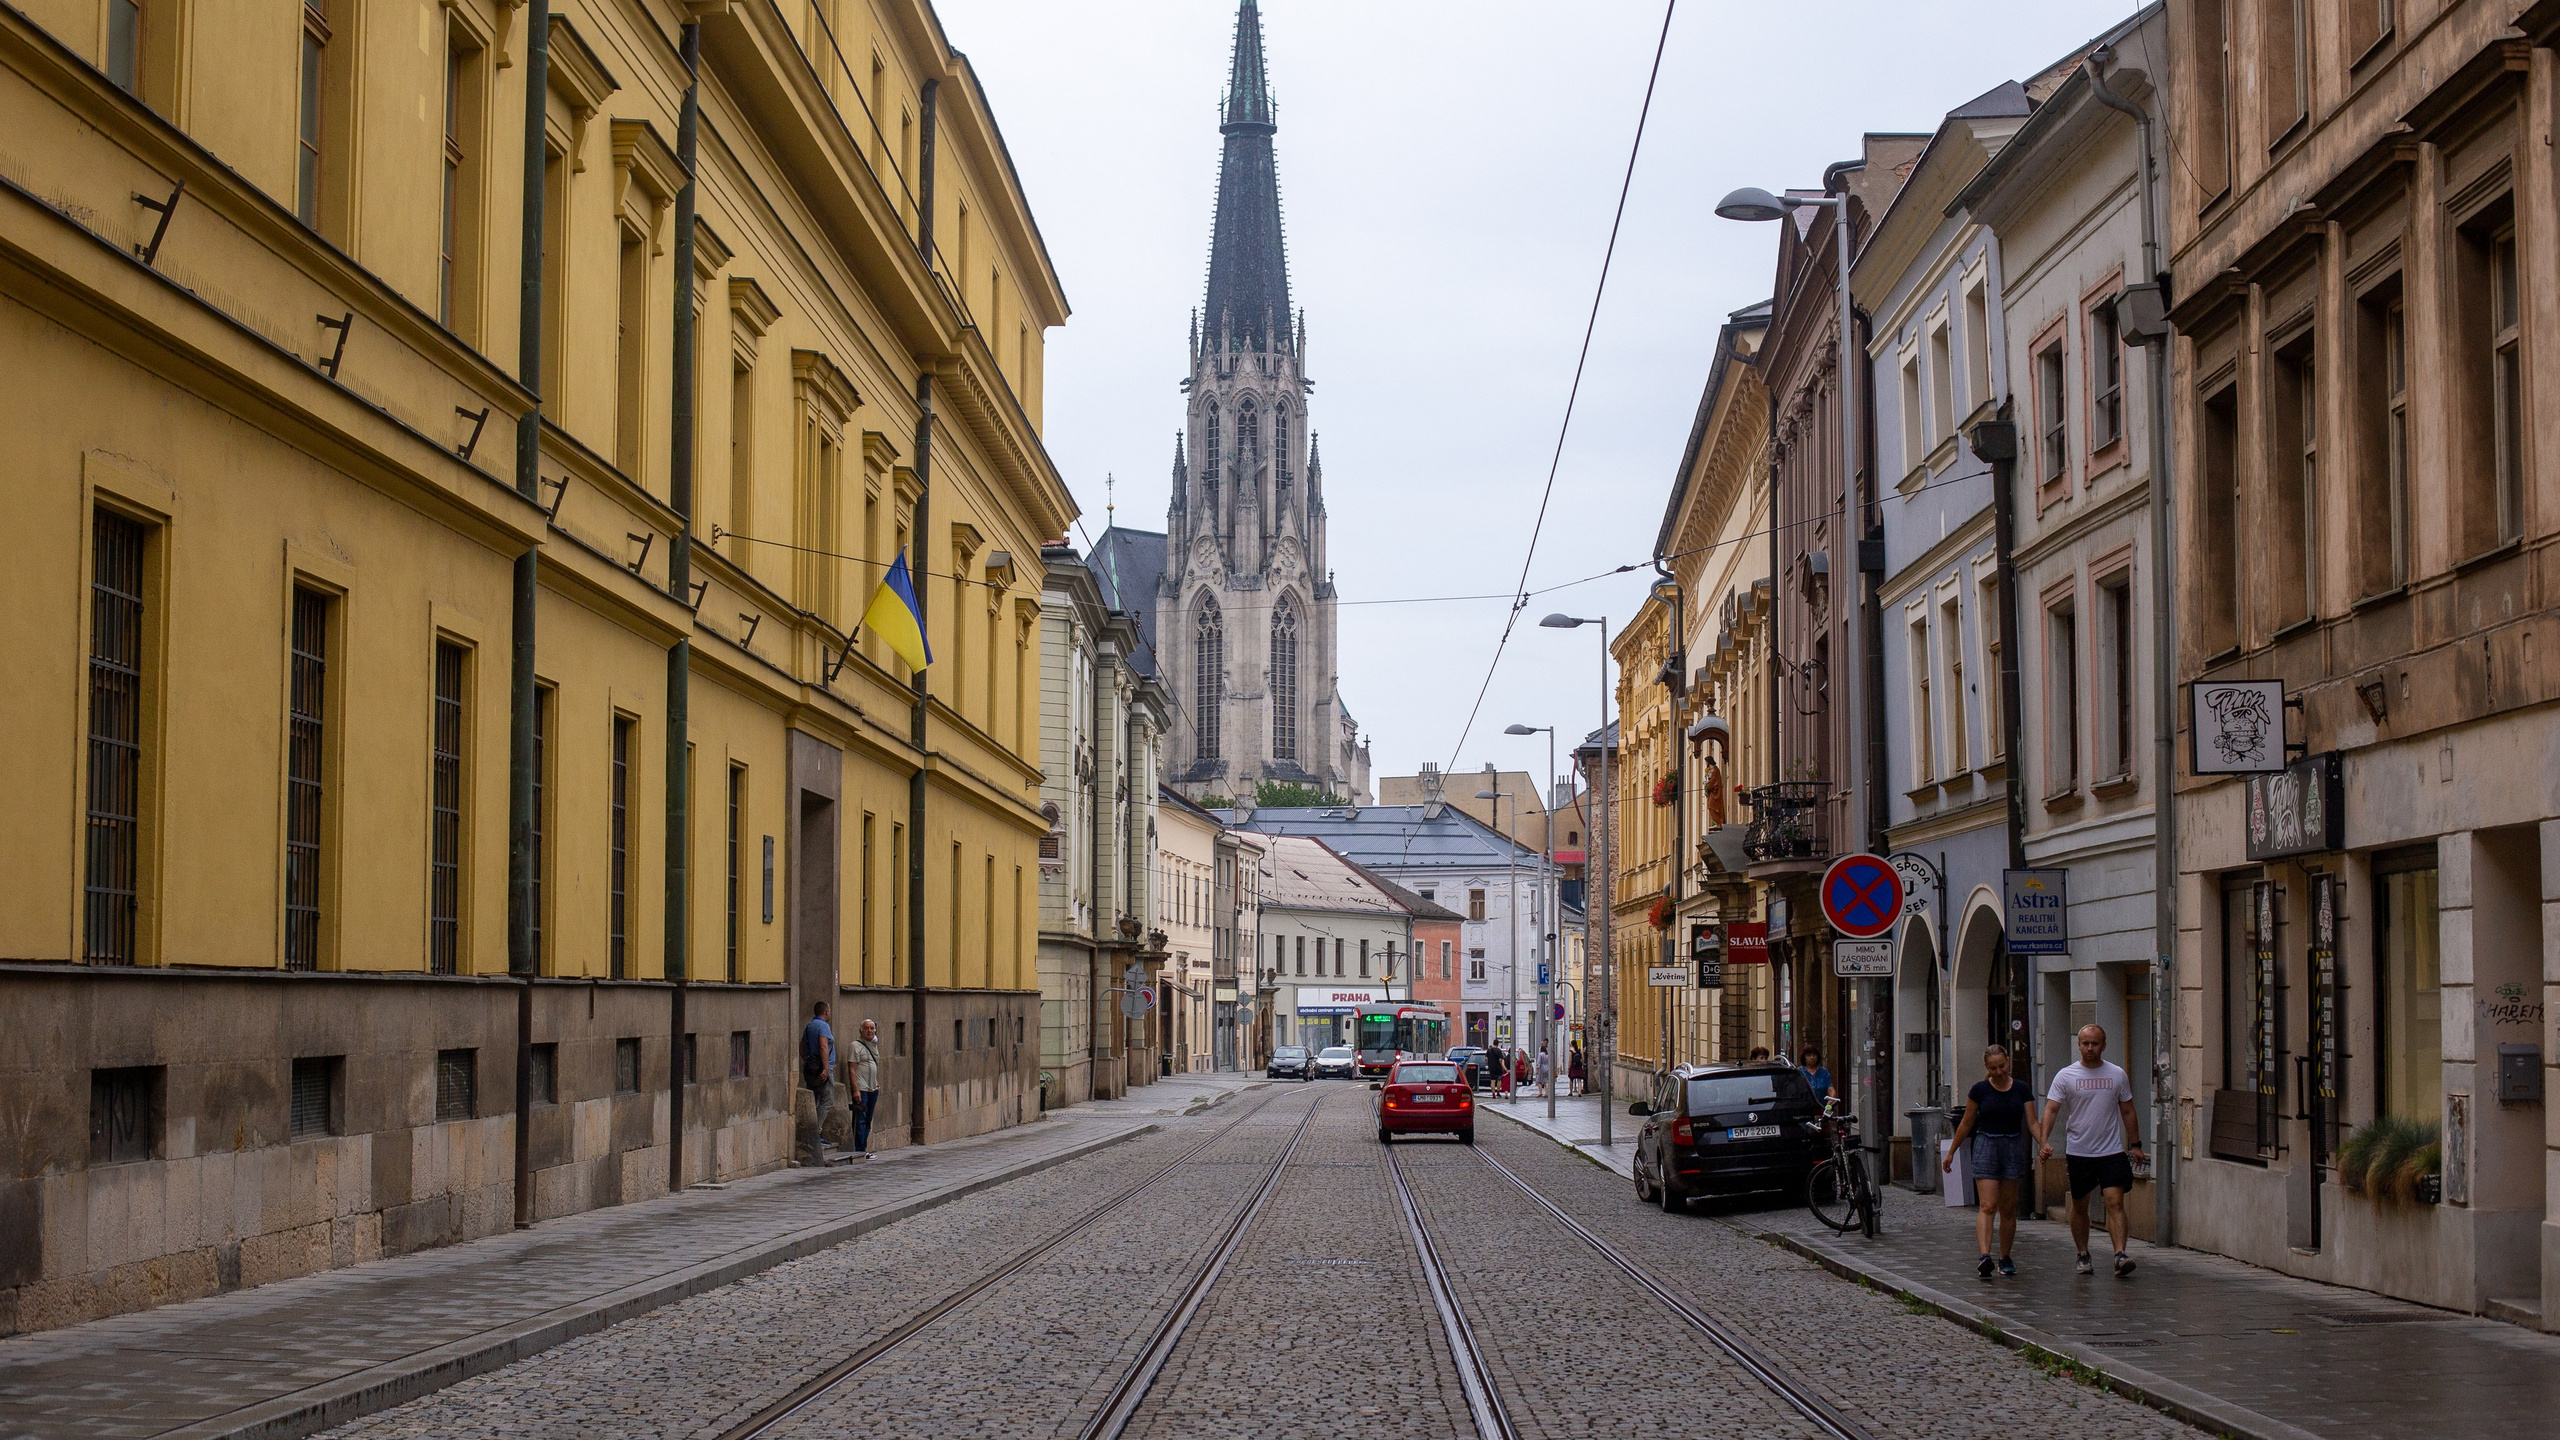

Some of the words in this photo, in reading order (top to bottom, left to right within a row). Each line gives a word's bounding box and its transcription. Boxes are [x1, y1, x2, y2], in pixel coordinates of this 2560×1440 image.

[1896, 862, 1931, 885] SPODA
[1906, 898, 1927, 913] SEA
[2011, 892, 2059, 909] Astra
[2019, 912, 2056, 923] REALITNÍ
[2016, 924, 2059, 934] KANCELÁŘ
[1730, 937, 1766, 946] SLAVIA
[2011, 942, 2062, 950] www.rkastra.cz
[1841, 954, 1889, 963] ZÁSOBOVÁNÍ
[1652, 972, 1686, 982] Květiny
[1332, 993, 1371, 1002] PRAHA
[2076, 1078, 2113, 1091] PUMA
[1734, 1127, 1749, 1137] 5M7
[1756, 1126, 1777, 1136] 2020
